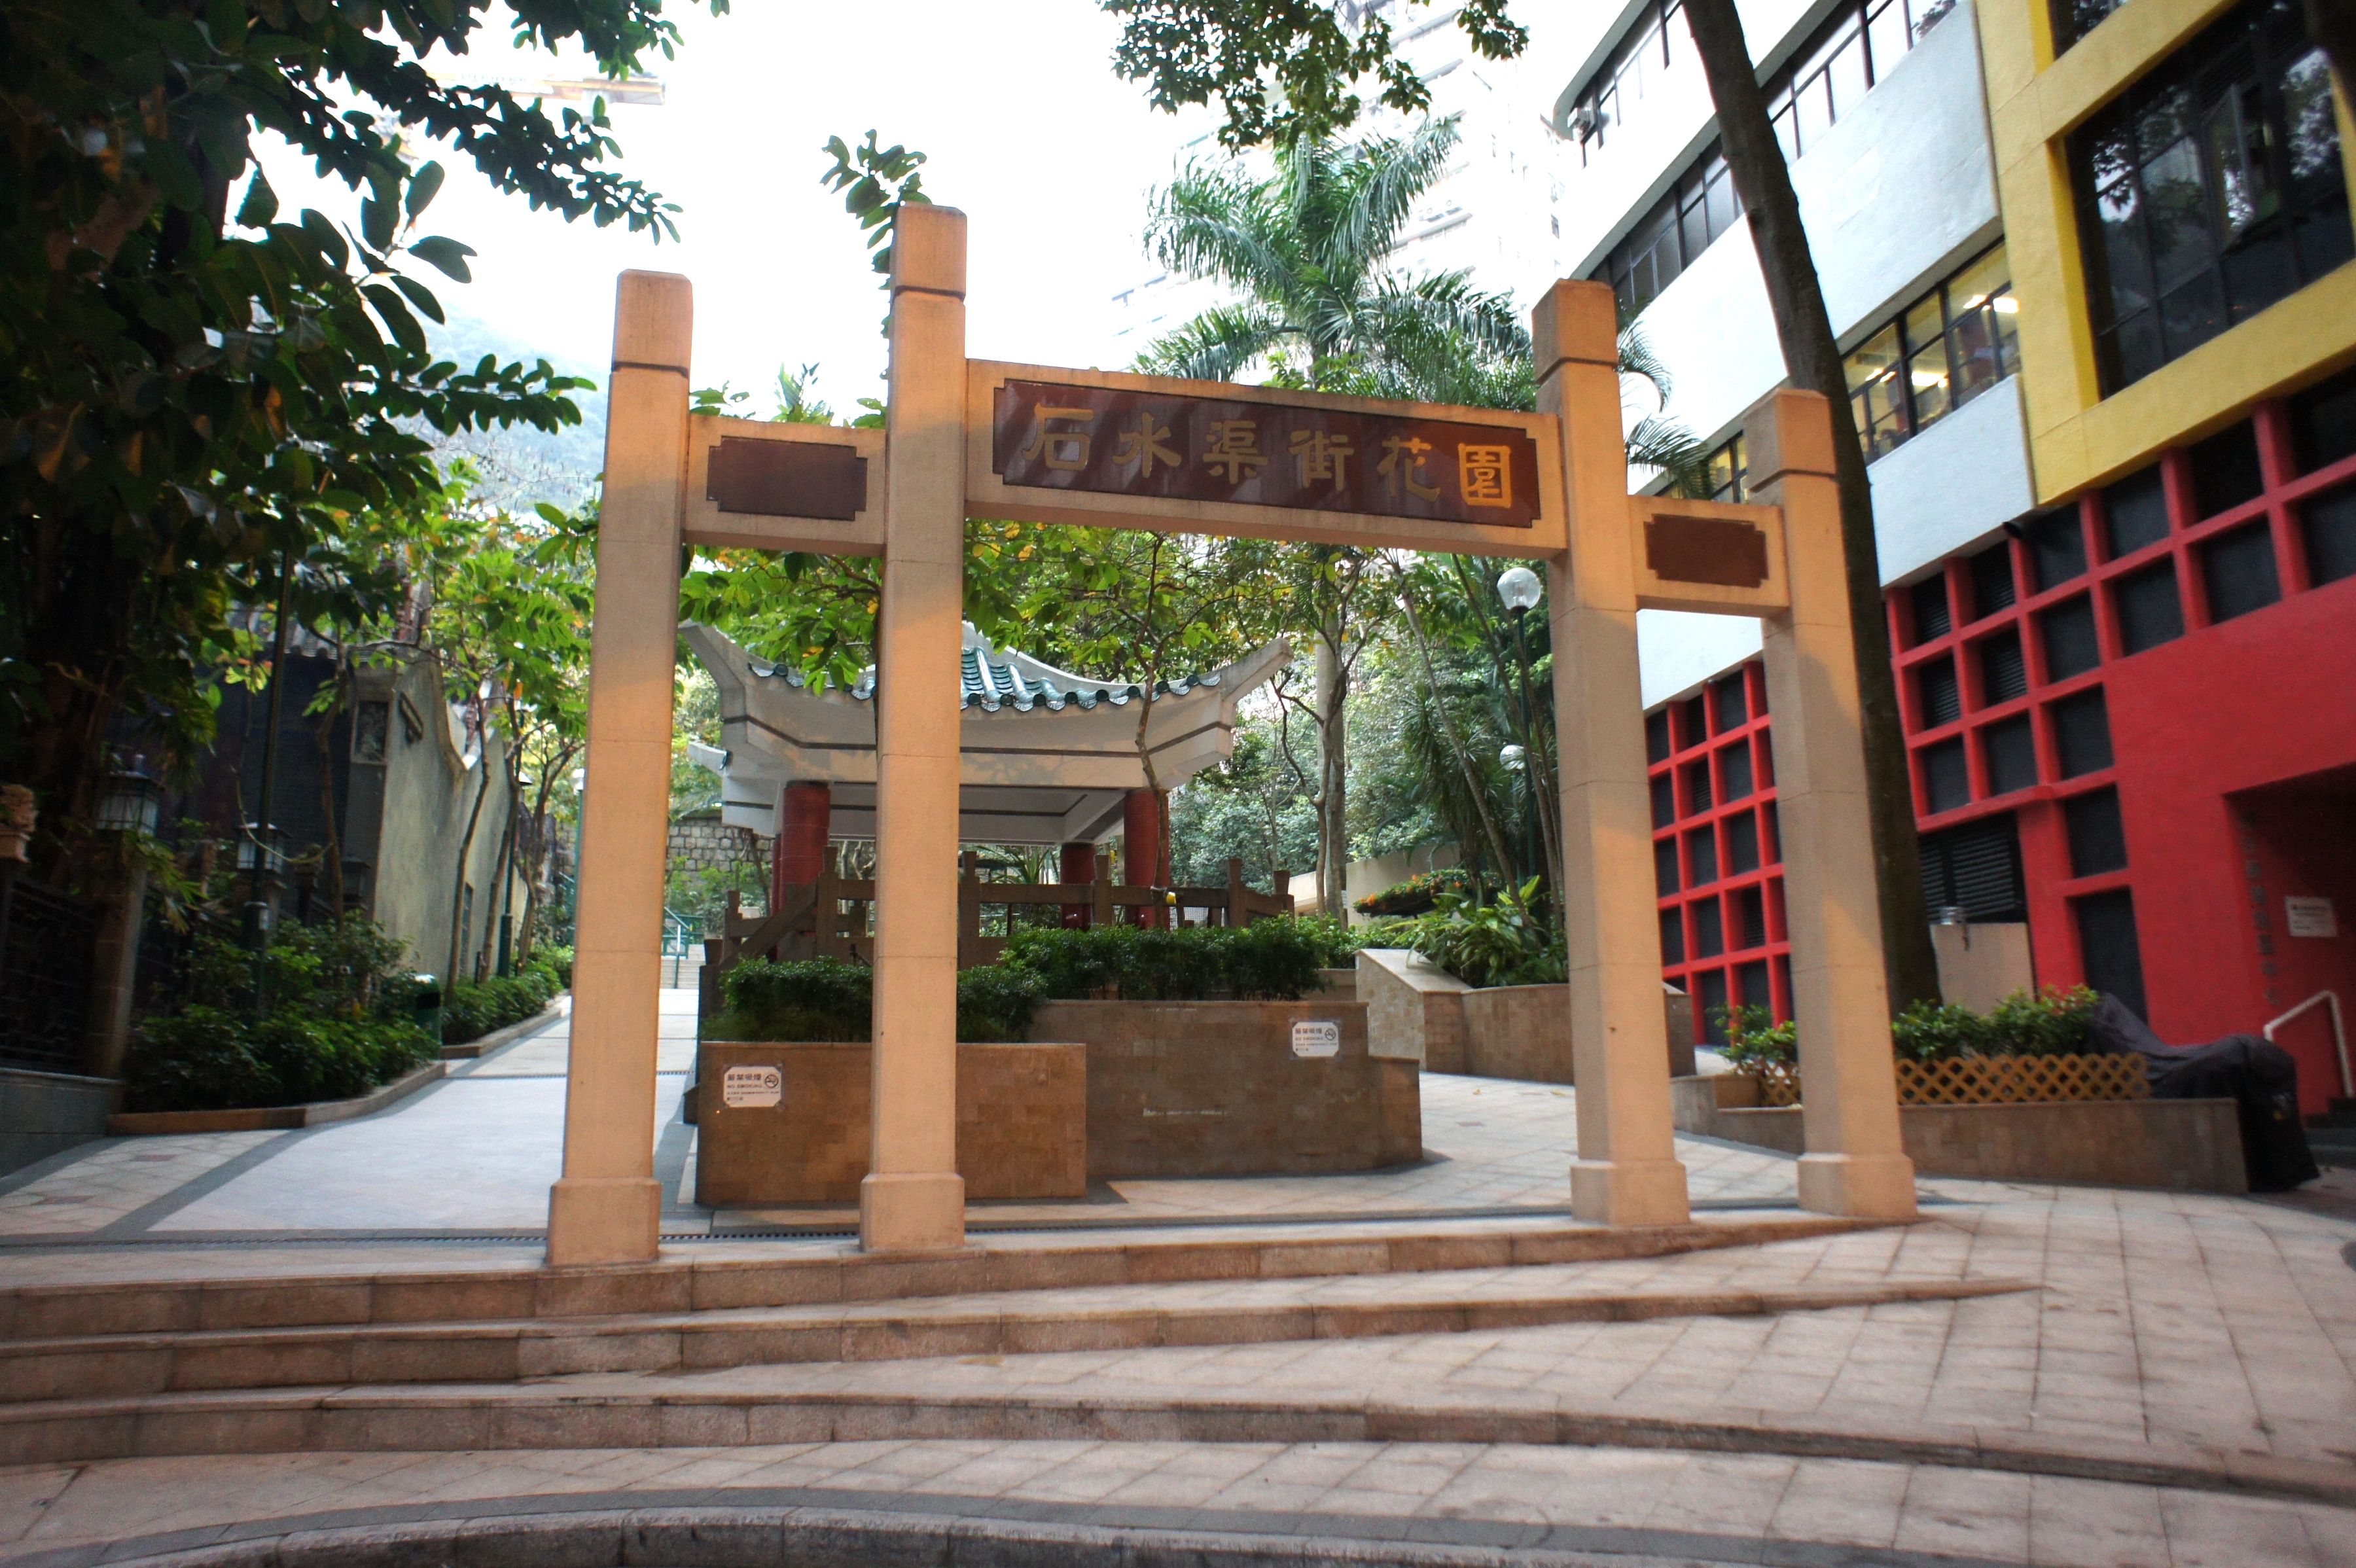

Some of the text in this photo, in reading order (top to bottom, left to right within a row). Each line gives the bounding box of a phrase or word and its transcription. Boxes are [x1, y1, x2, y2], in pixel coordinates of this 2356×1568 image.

[1022, 402, 1513, 510] 石水渠街花園
